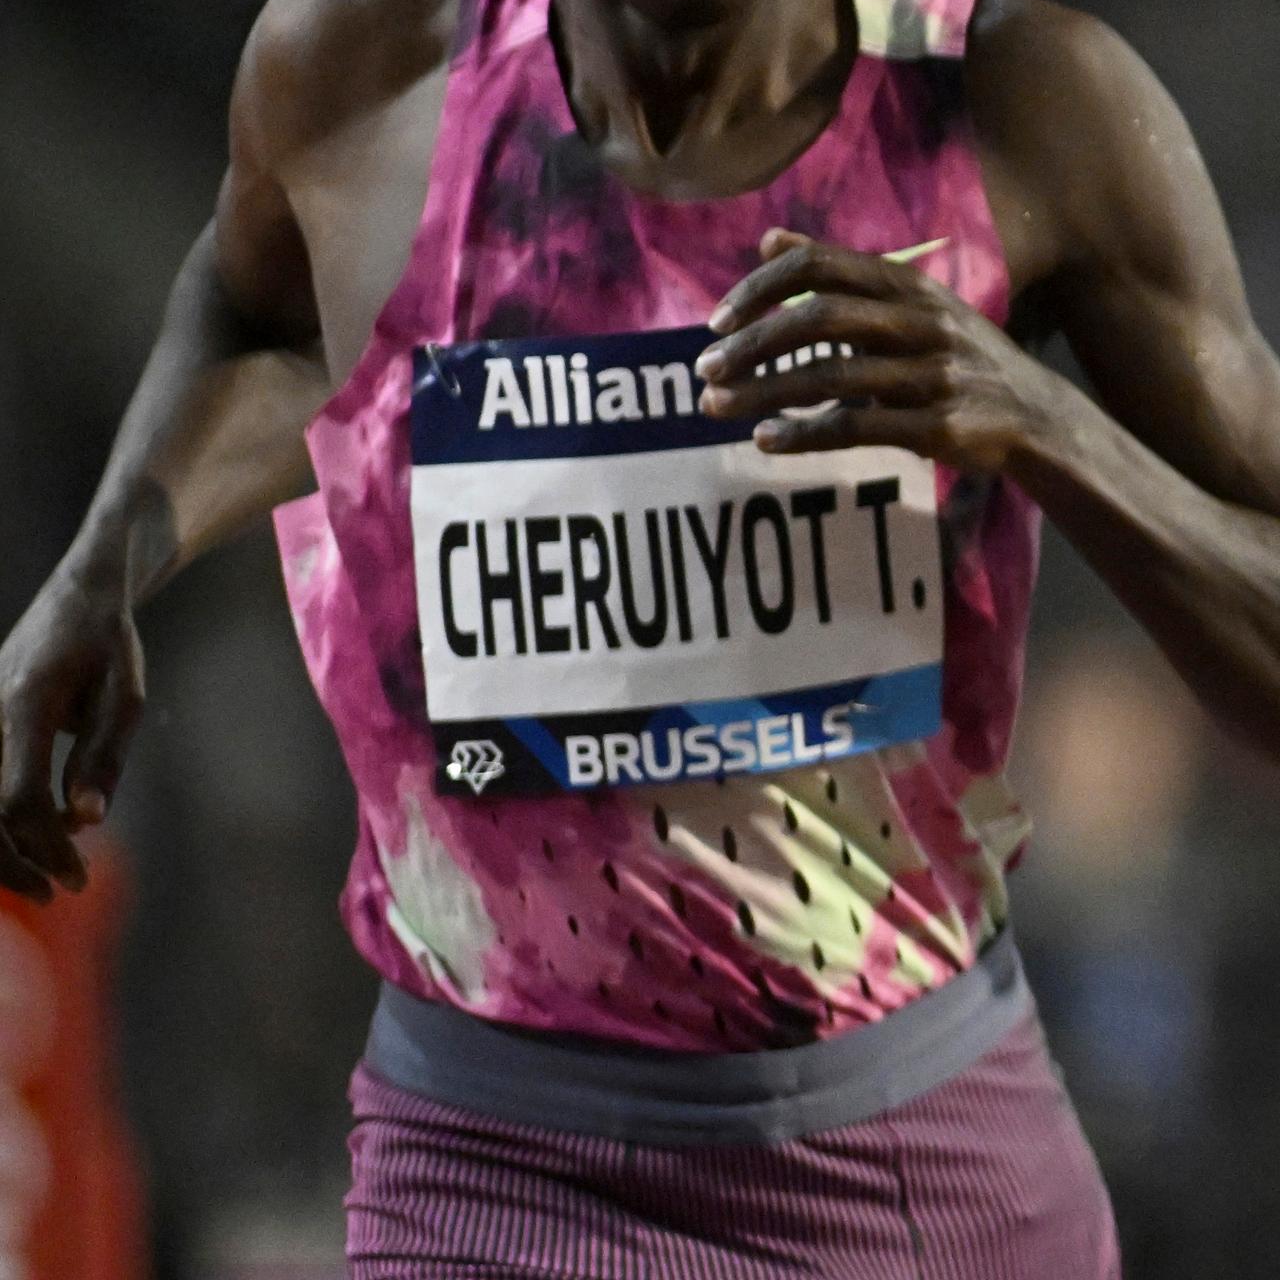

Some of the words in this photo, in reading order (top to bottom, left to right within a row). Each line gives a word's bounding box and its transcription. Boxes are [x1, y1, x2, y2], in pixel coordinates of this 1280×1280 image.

[478, 352, 706, 430] Allian
[438, 486, 838, 659] CHERUIYOT
[856, 476, 928, 611] T.
[565, 703, 854, 787] BRUSSELS
